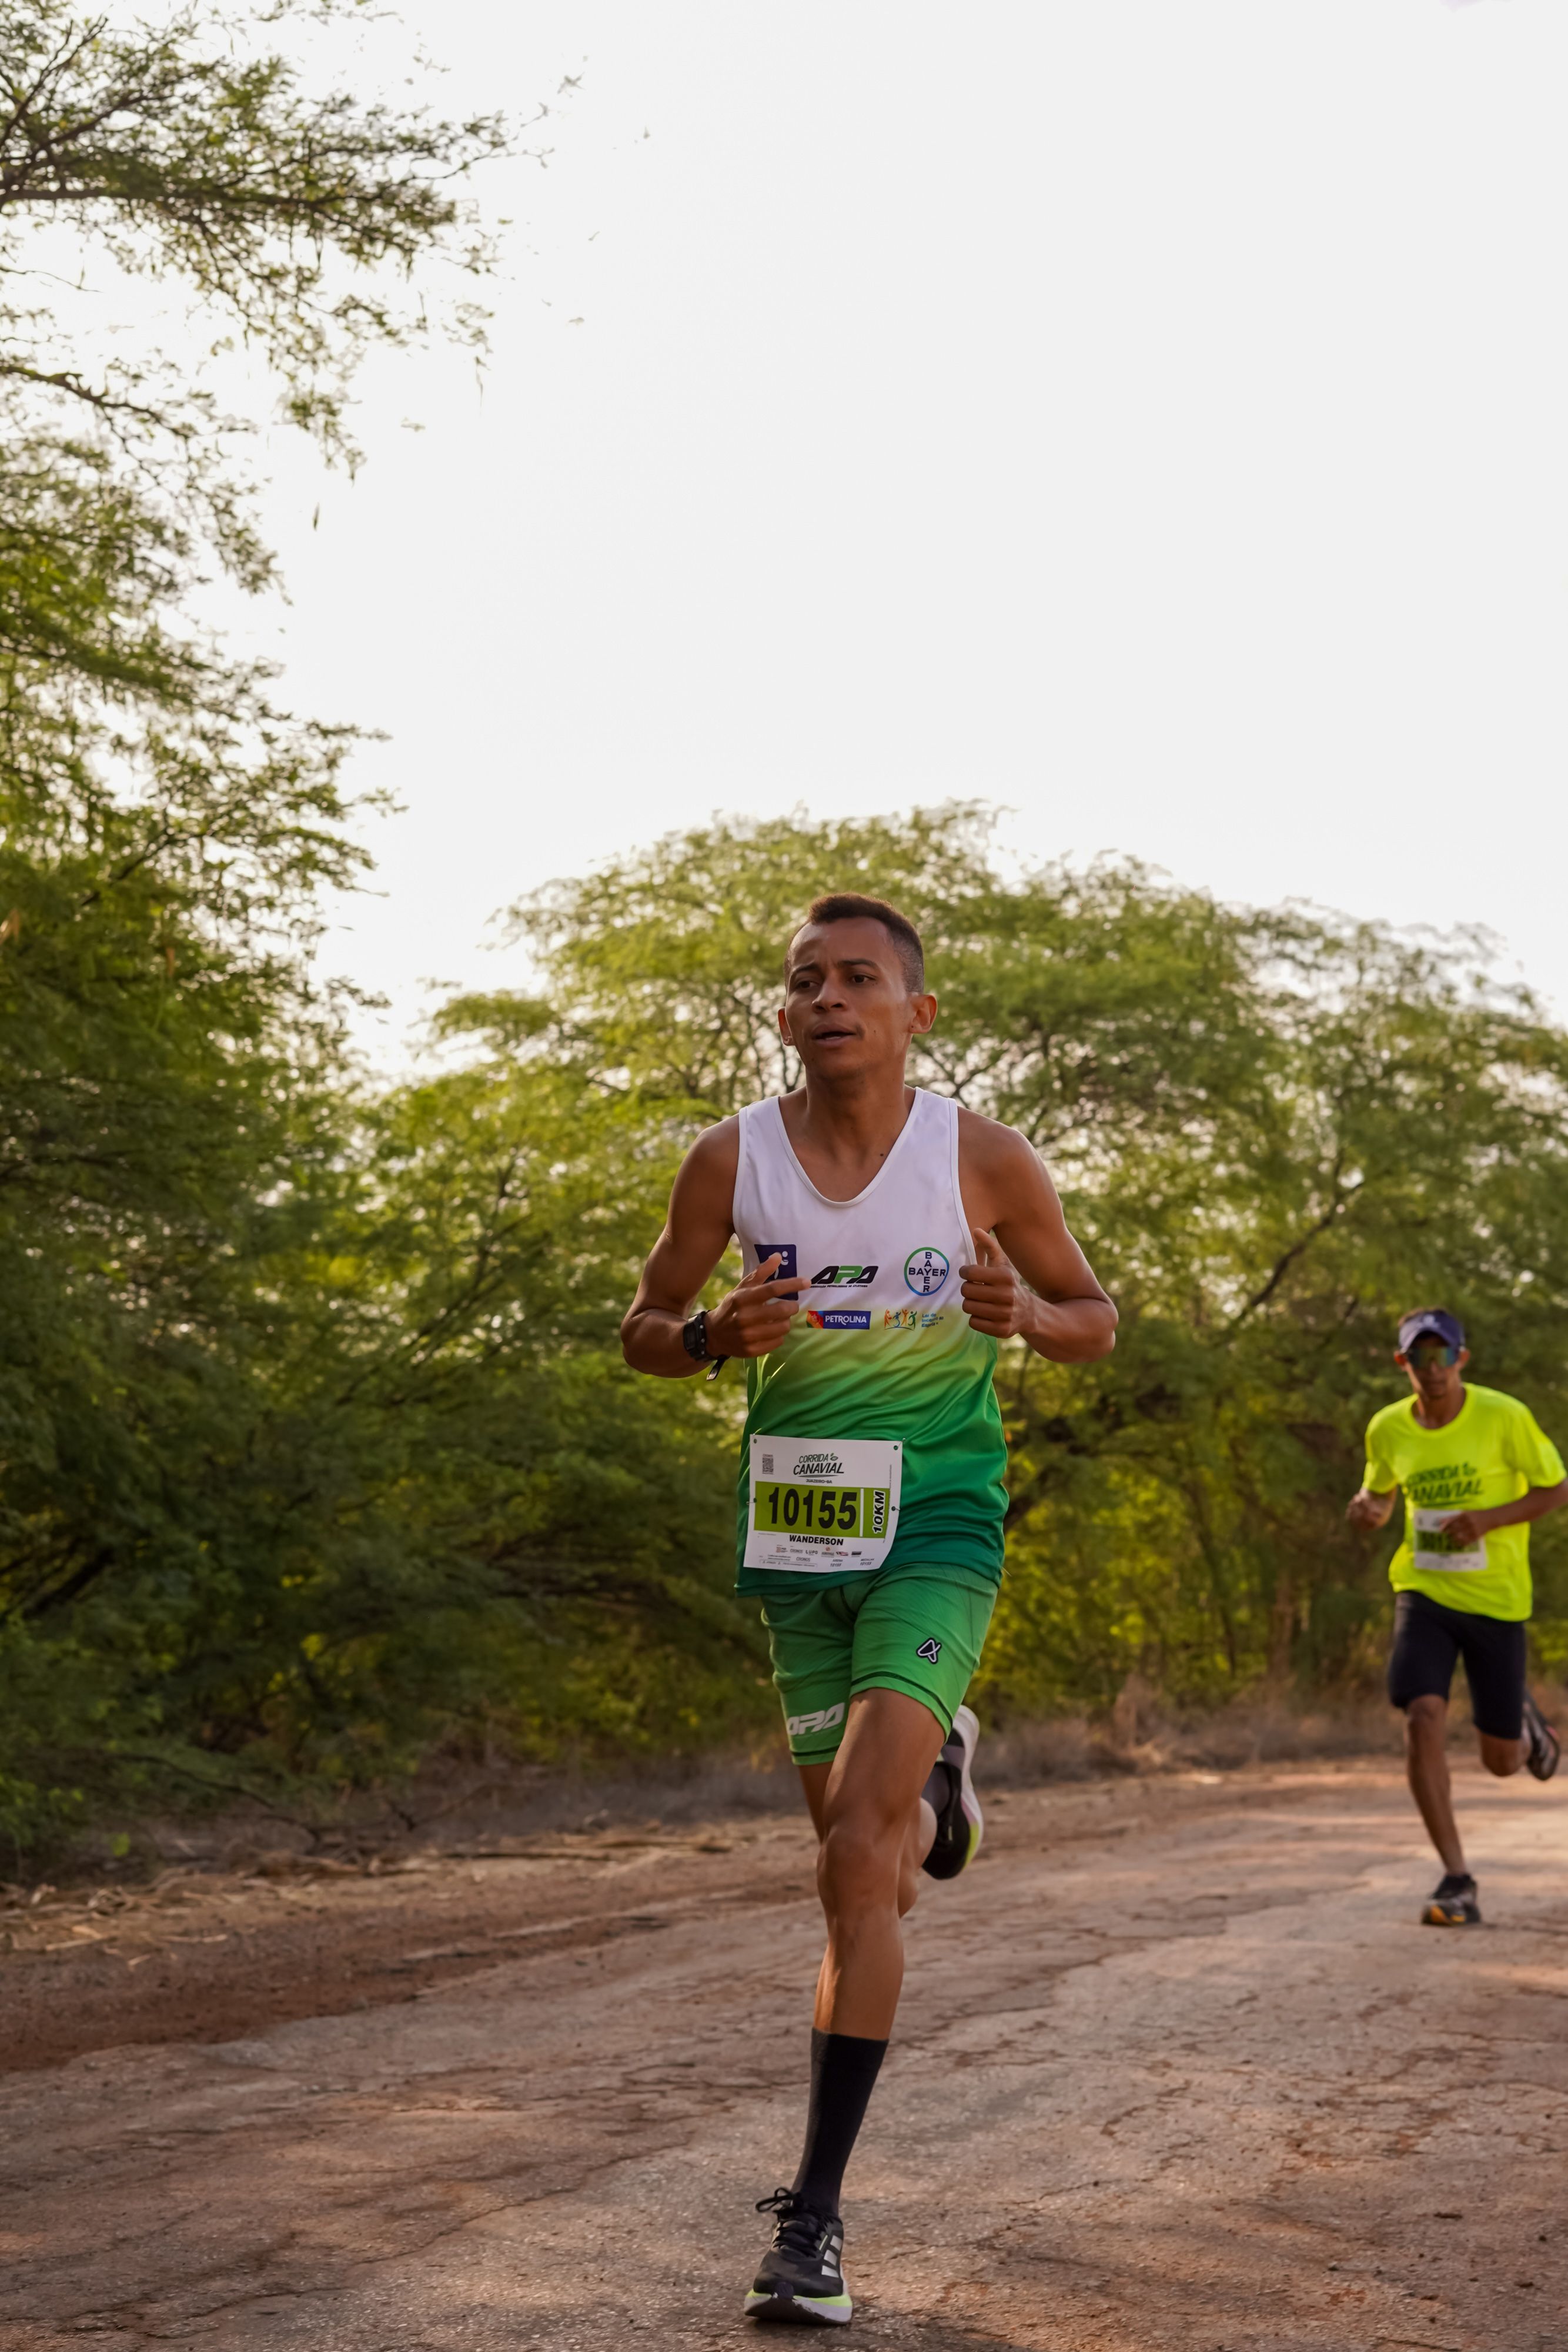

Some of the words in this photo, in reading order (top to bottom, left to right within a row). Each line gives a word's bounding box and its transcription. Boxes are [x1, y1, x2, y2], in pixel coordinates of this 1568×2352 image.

[811, 1265, 878, 1284] APA
[908, 1267, 946, 1277] BAYER
[825, 1315, 867, 1325] PETROLINA
[798, 1453, 829, 1464] CORRIDA
[793, 1462, 844, 1475] CANAVIAL
[768, 1487, 858, 1530] 10155
[873, 1490, 885, 1534] 10KM
[789, 1535, 844, 1546] WANDERSON
